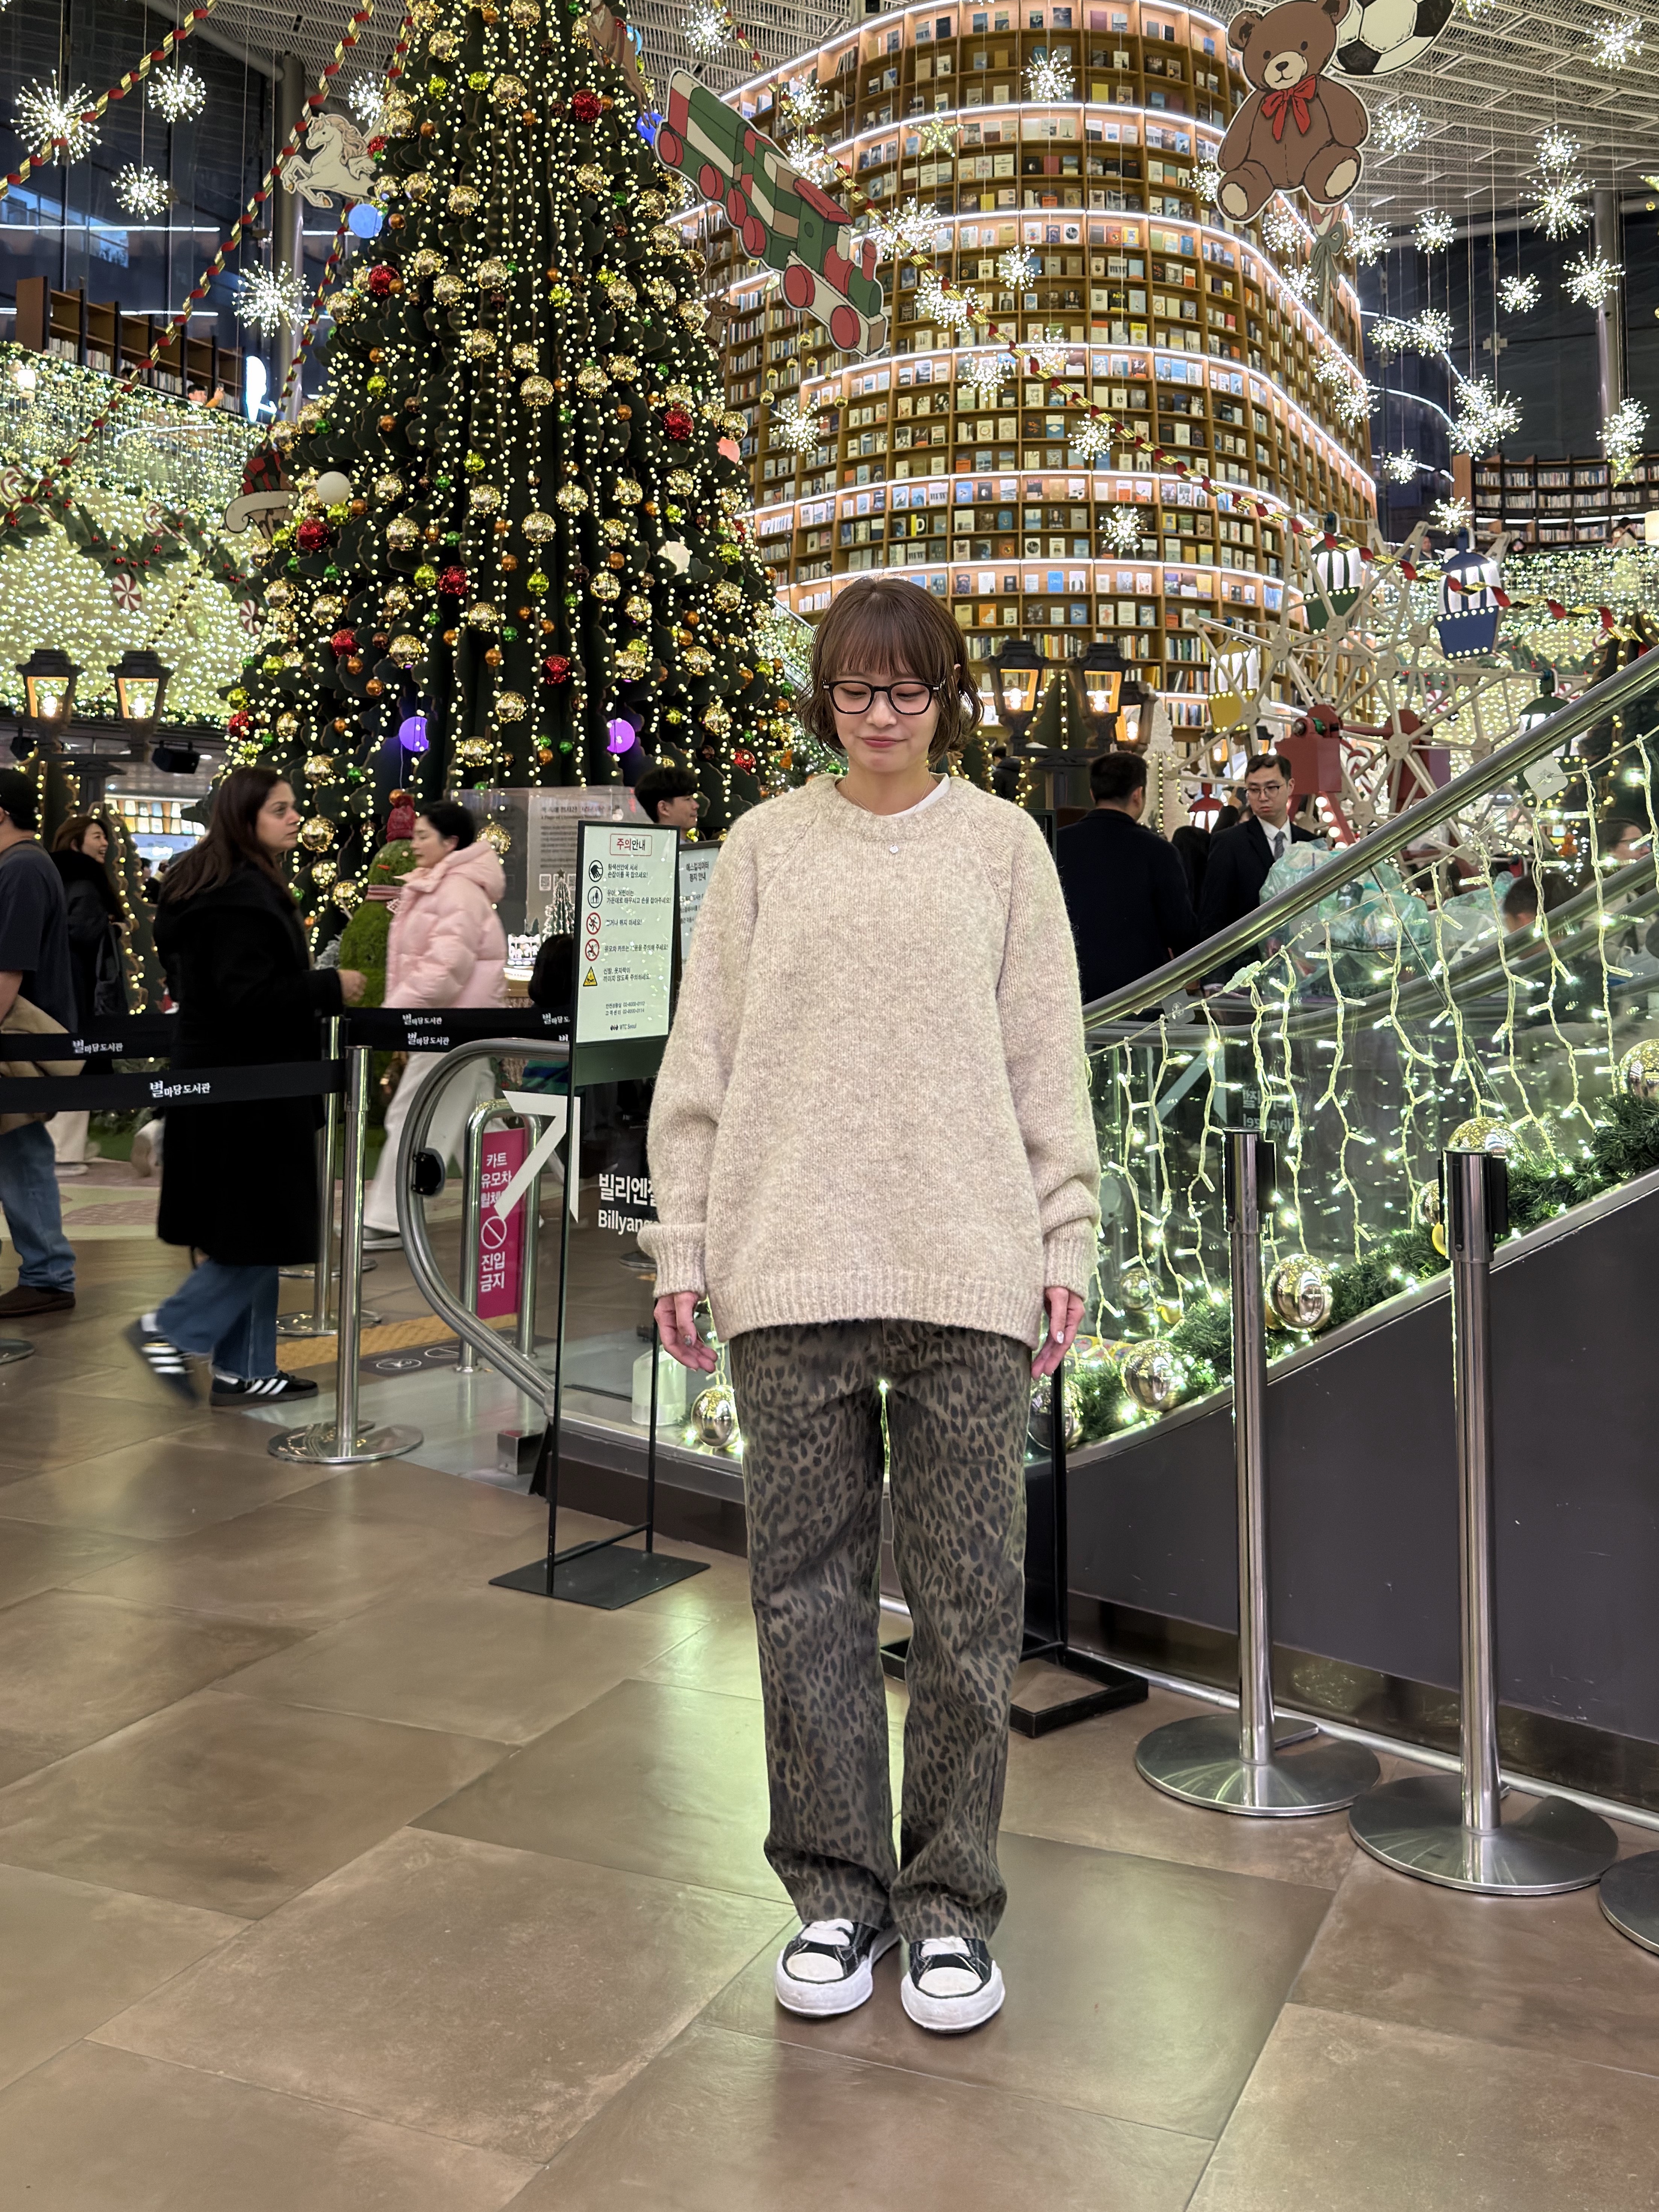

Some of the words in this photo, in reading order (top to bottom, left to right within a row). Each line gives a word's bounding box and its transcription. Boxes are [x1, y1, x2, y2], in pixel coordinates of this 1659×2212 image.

[617, 838, 645, 851] 주의안내
[150, 1080, 211, 1098] 별마당도서관
[486, 1152, 507, 1169] 카트
[481, 1170, 512, 1189] 유모차
[598, 1209, 659, 1235] Billyan
[481, 1251, 505, 1272] 진입
[480, 1271, 505, 1292] 금지
